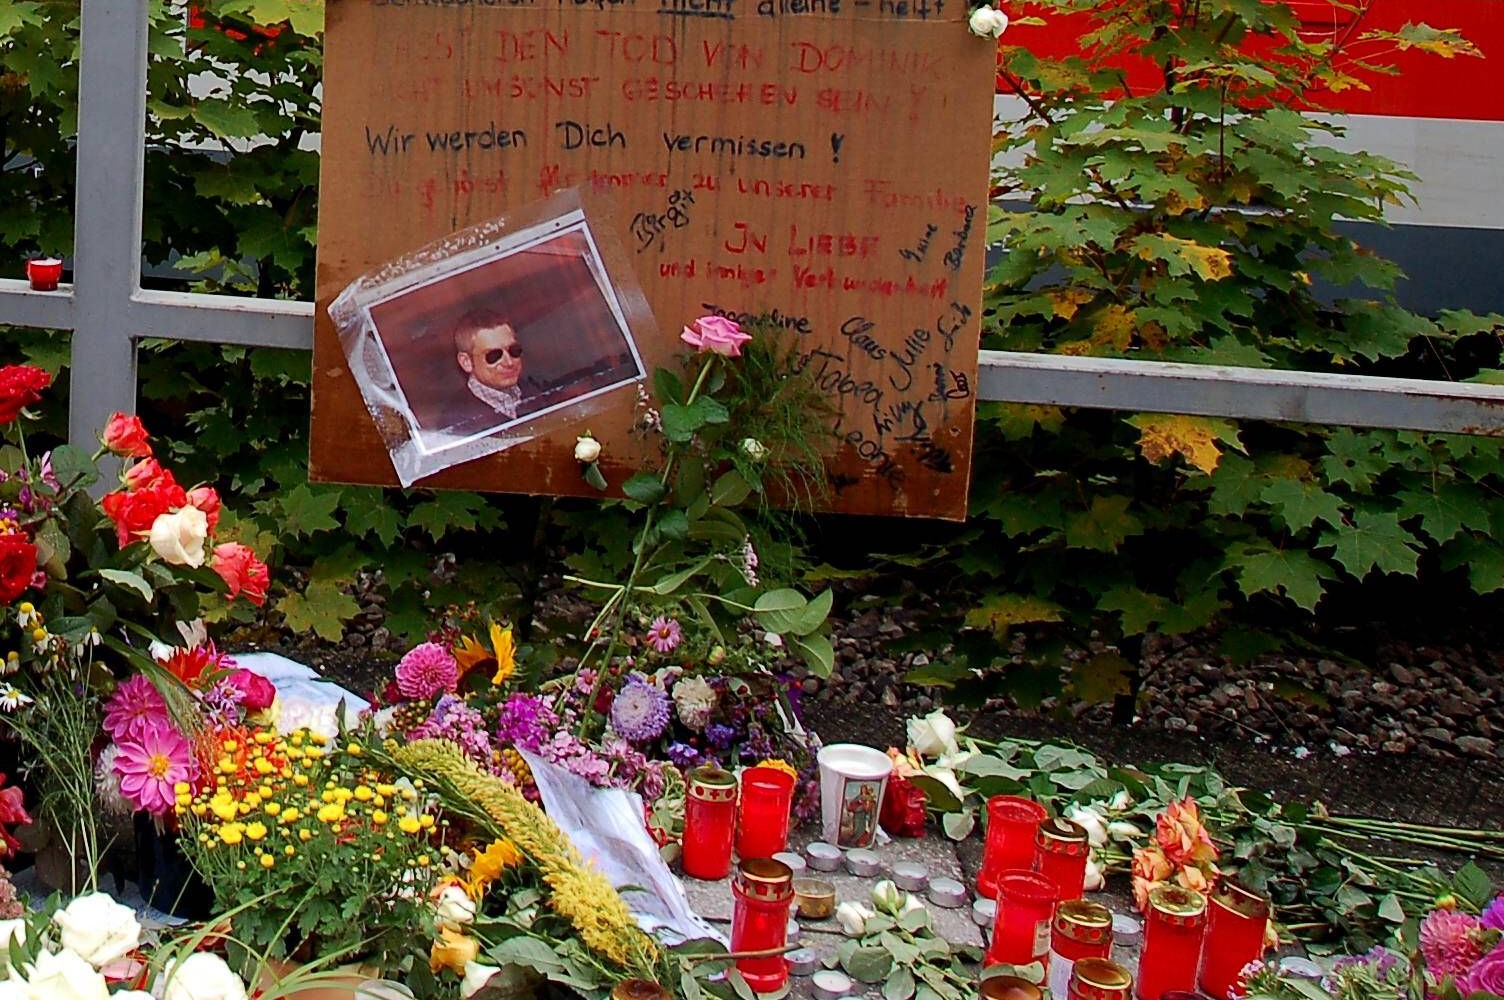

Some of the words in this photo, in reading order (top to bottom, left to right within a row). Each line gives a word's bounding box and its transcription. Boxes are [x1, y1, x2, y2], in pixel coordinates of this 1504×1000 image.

[495, 29, 569, 62] DEN
[365, 125, 417, 155] Wir
[426, 121, 528, 151] werden
[555, 120, 627, 150] Dich
[662, 132, 807, 160] vermissen
